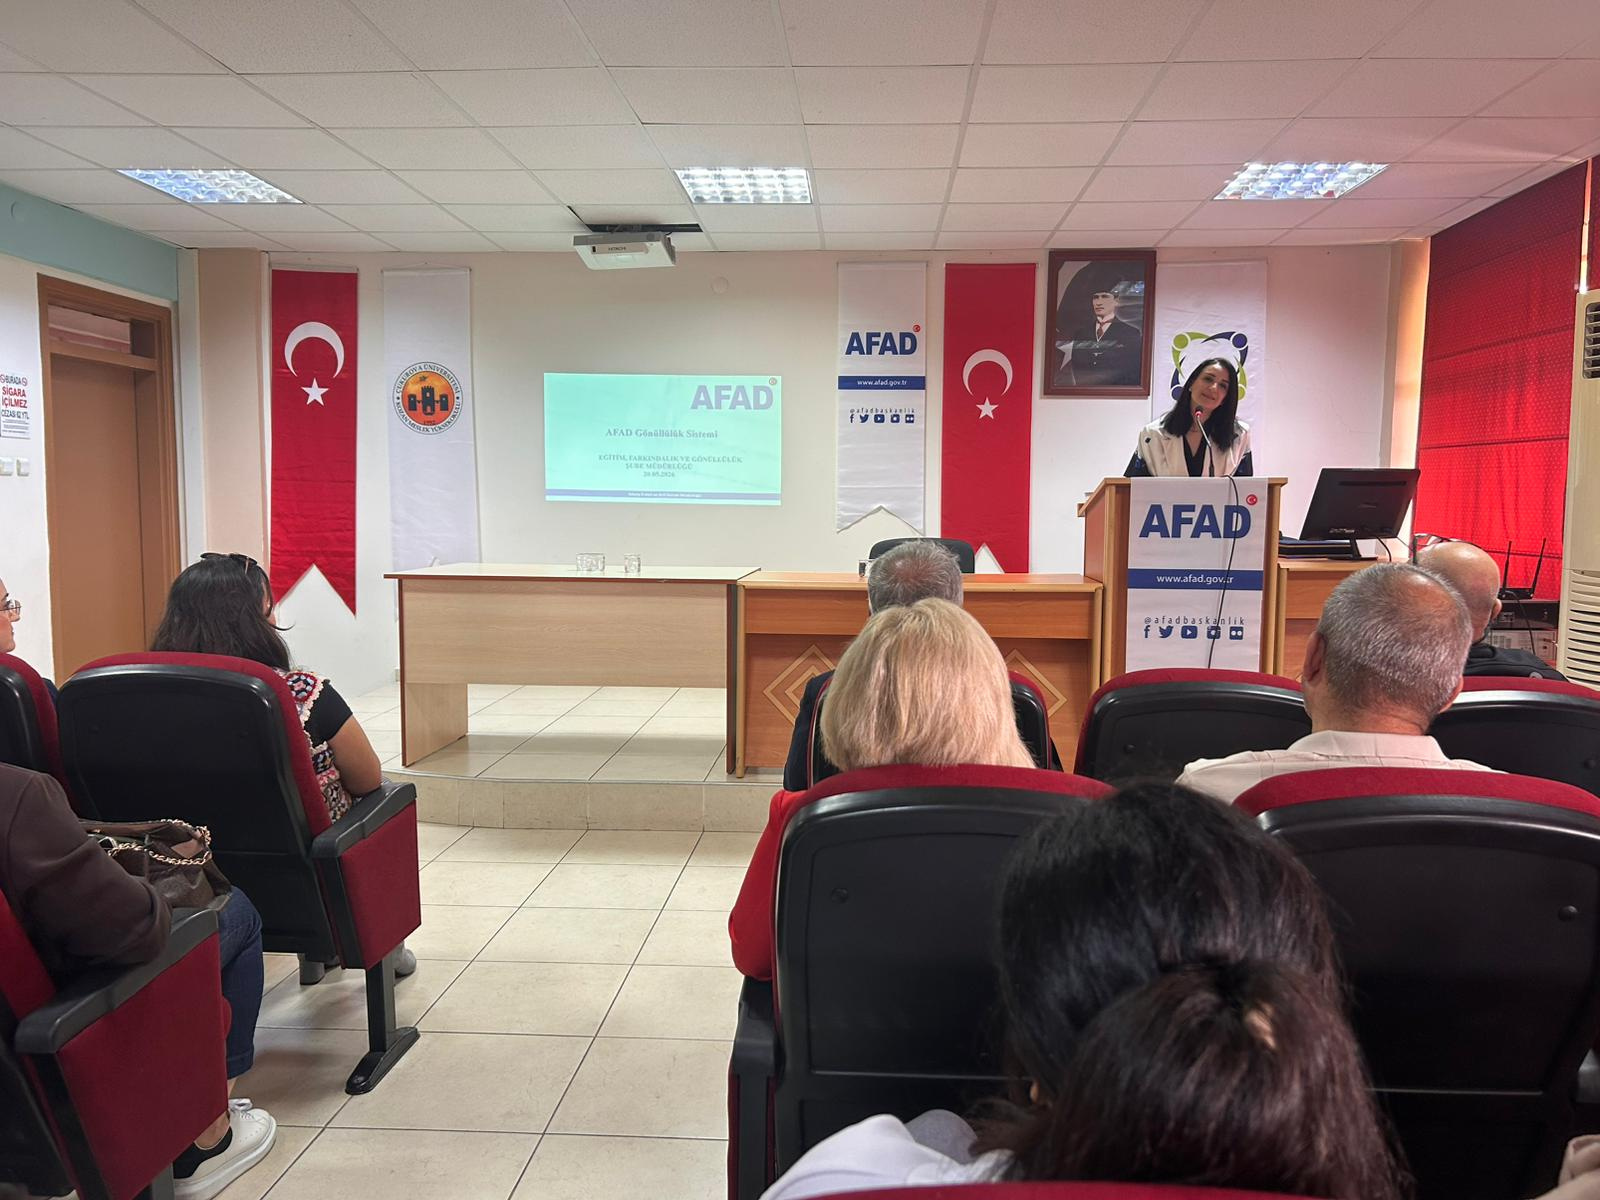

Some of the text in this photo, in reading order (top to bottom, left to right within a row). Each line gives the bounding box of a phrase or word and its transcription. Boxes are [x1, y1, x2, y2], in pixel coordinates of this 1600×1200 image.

[845, 332, 917, 355] AFAD
[2, 385, 26, 398] SİGARA
[690, 384, 774, 410] AFAD
[2, 396, 28, 408] İÇİLMEZ
[605, 428, 718, 439] AFAD Gönüllülük Sistemi
[1139, 504, 1251, 538] AFAD
[1144, 616, 1244, 625] @afadbaskanlik
